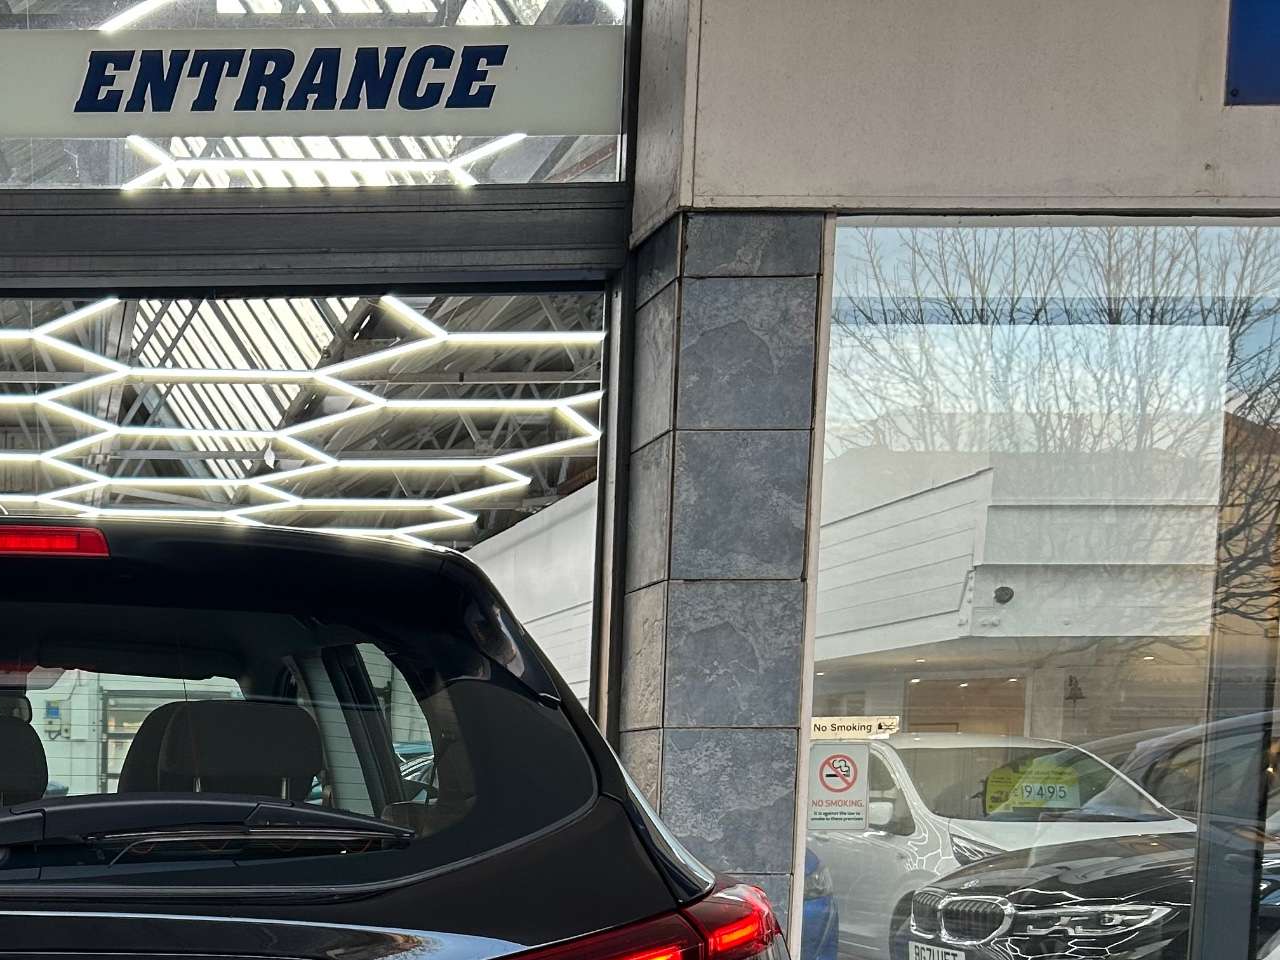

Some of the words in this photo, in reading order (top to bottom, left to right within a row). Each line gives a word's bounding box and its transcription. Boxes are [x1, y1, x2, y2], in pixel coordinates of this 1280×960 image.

[73, 44, 509, 113] ENTRANCE
[813, 723, 827, 732] No
[830, 723, 872, 734] Smoking
[811, 799, 824, 807] NO
